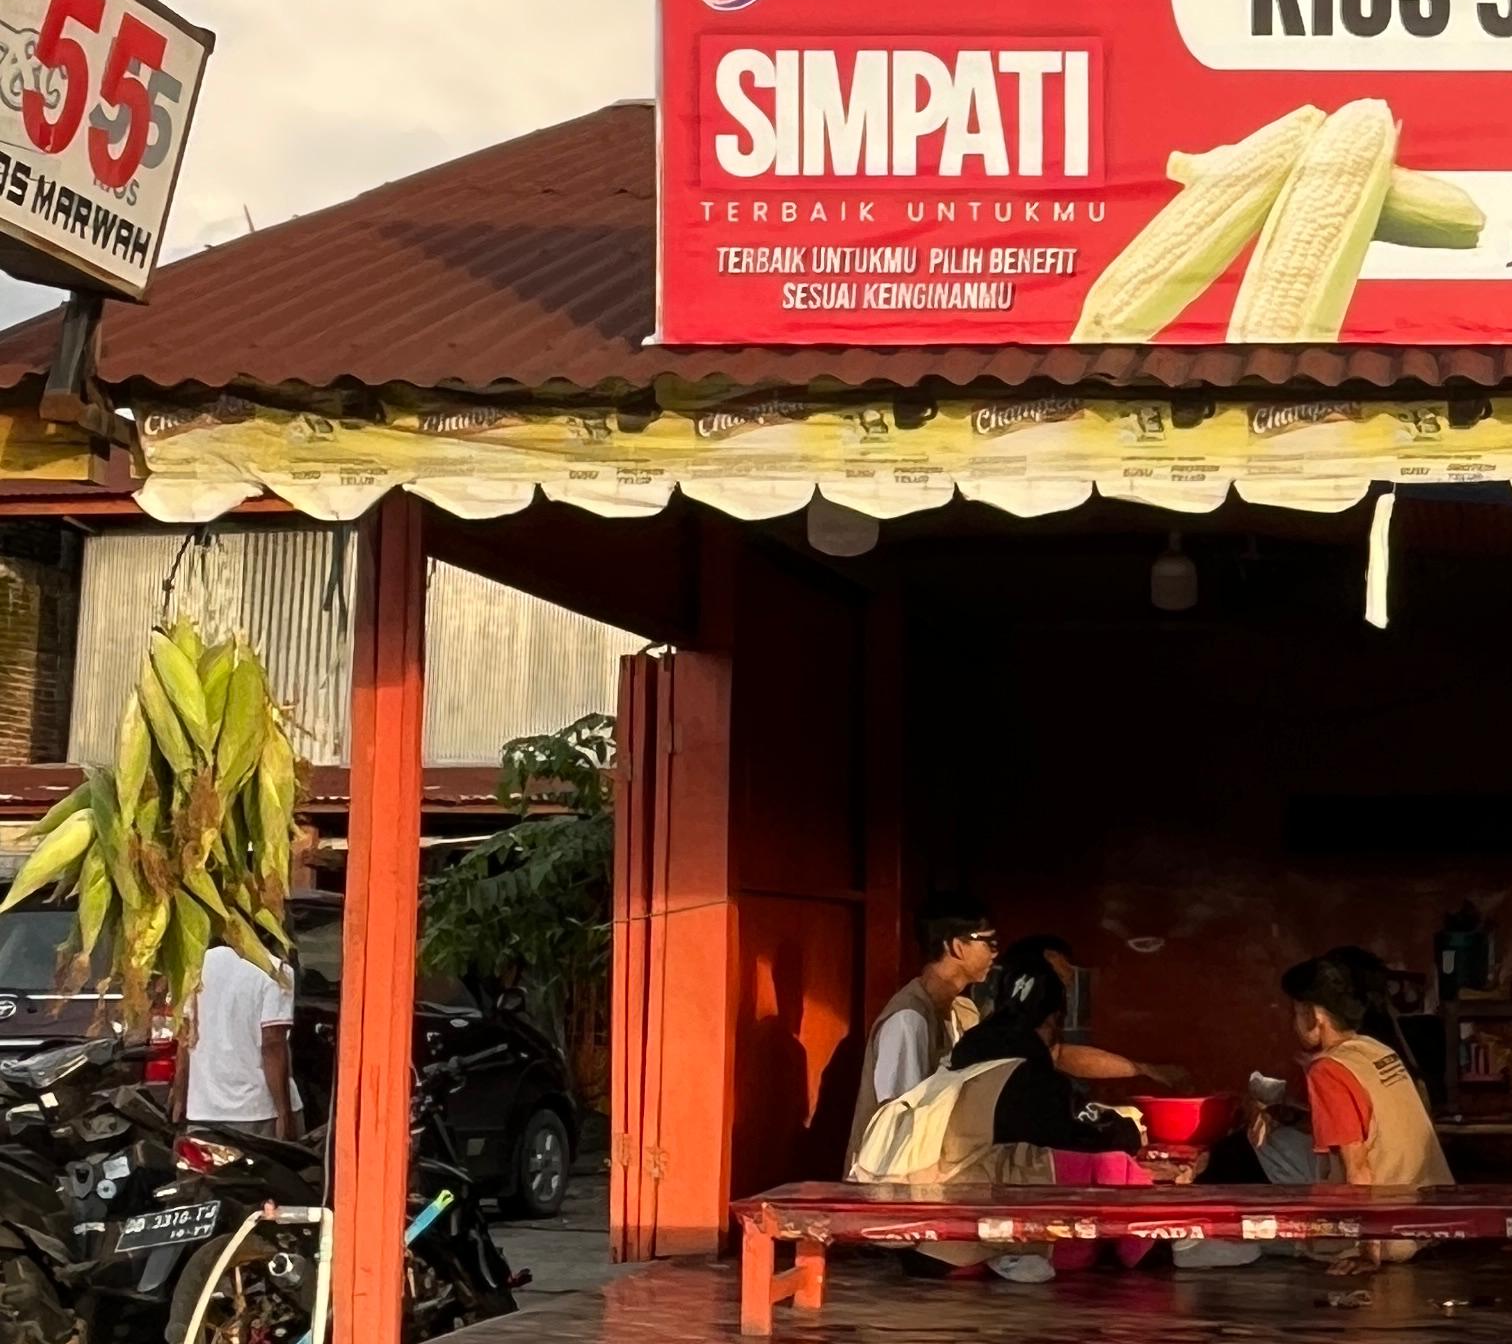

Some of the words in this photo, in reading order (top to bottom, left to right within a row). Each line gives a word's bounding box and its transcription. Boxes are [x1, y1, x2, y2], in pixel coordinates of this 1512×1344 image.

[714, 48, 1090, 178] SIMPATI
[31, 175, 152, 269] MARWAH
[700, 201, 875, 223] TERBAIK
[906, 201, 1106, 223] UNTUKMU
[716, 246, 806, 274] TERBAIK
[811, 246, 918, 274] UNTUKMU
[928, 247, 983, 274] PILIH
[989, 247, 1079, 275] BENEFIT
[782, 282, 857, 310] SESUAI
[862, 282, 1015, 311] KEINGINANMU
